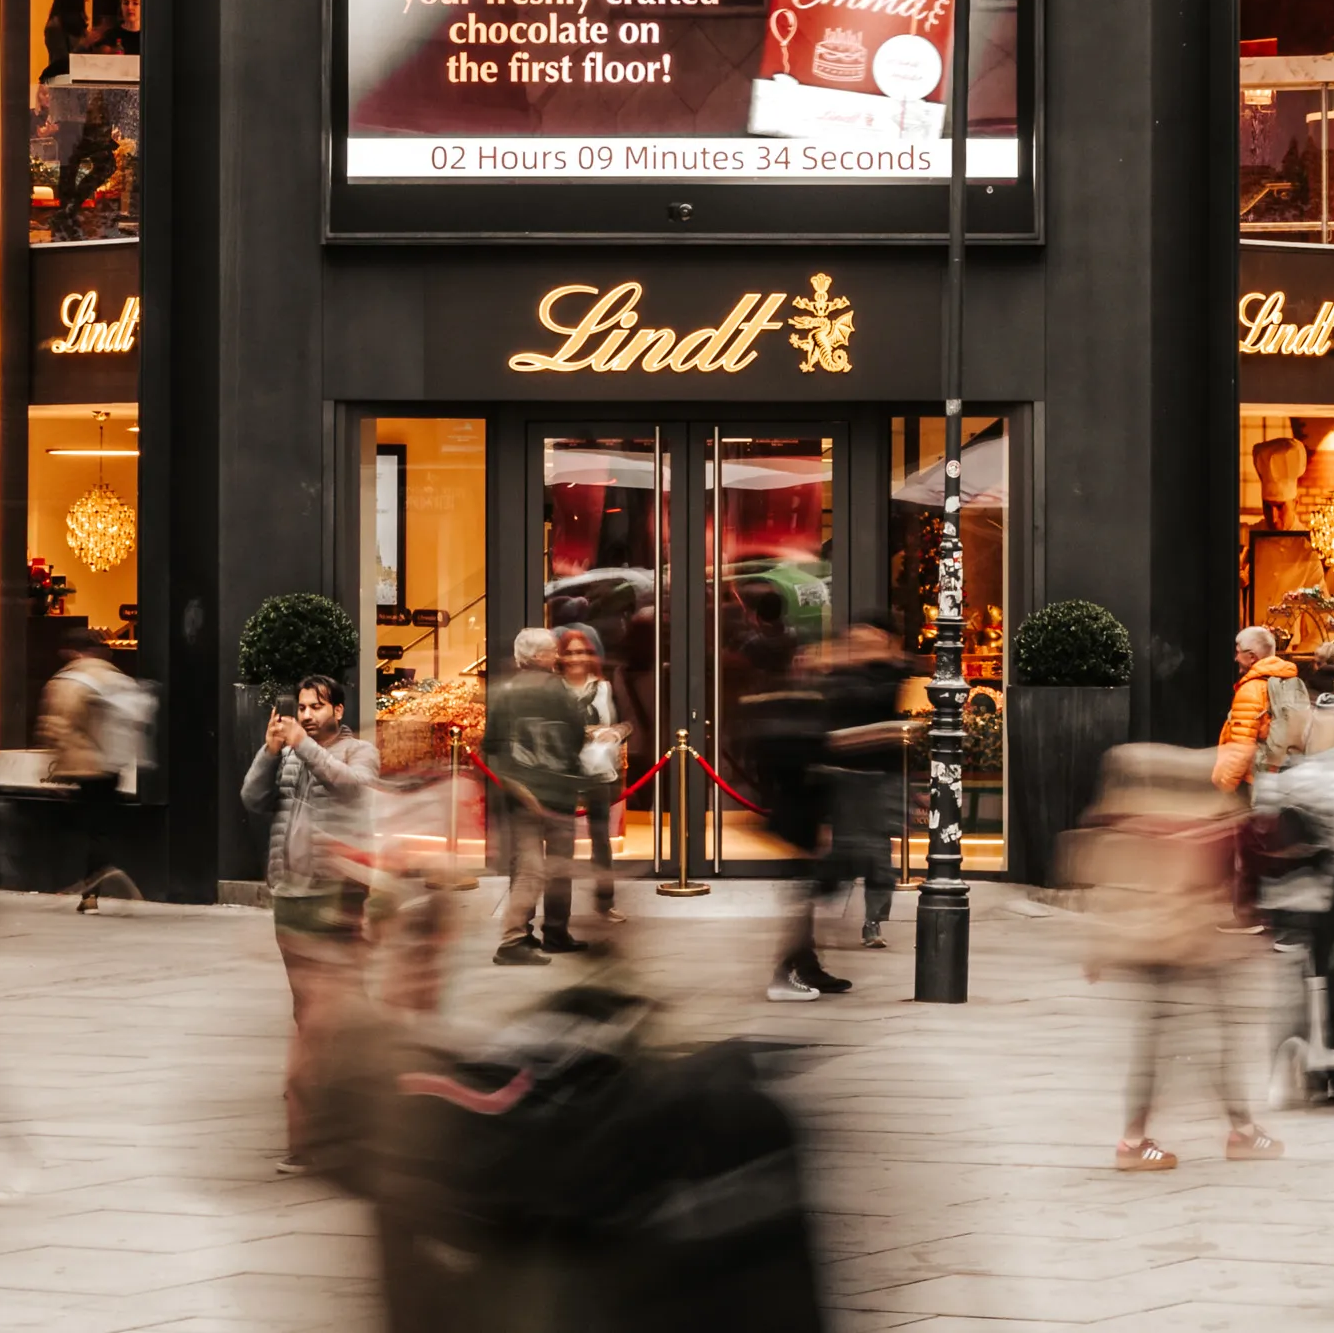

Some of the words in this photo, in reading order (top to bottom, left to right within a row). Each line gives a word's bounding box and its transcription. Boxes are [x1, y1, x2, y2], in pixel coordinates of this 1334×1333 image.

[448, 13, 609, 46] chocolate
[618, 20, 661, 46] on
[446, 53, 498, 84] the
[507, 52, 573, 84] first
[581, 52, 672, 84] floor!
[431, 147, 466, 171] 02
[478, 146, 566, 171] Hours
[578, 146, 613, 171] 09
[625, 146, 744, 171] Minutes
[756, 146, 791, 171] 34
[802, 144, 932, 171] Seconds
[50, 289, 140, 354] Lindt
[508, 280, 788, 374] Lindt
